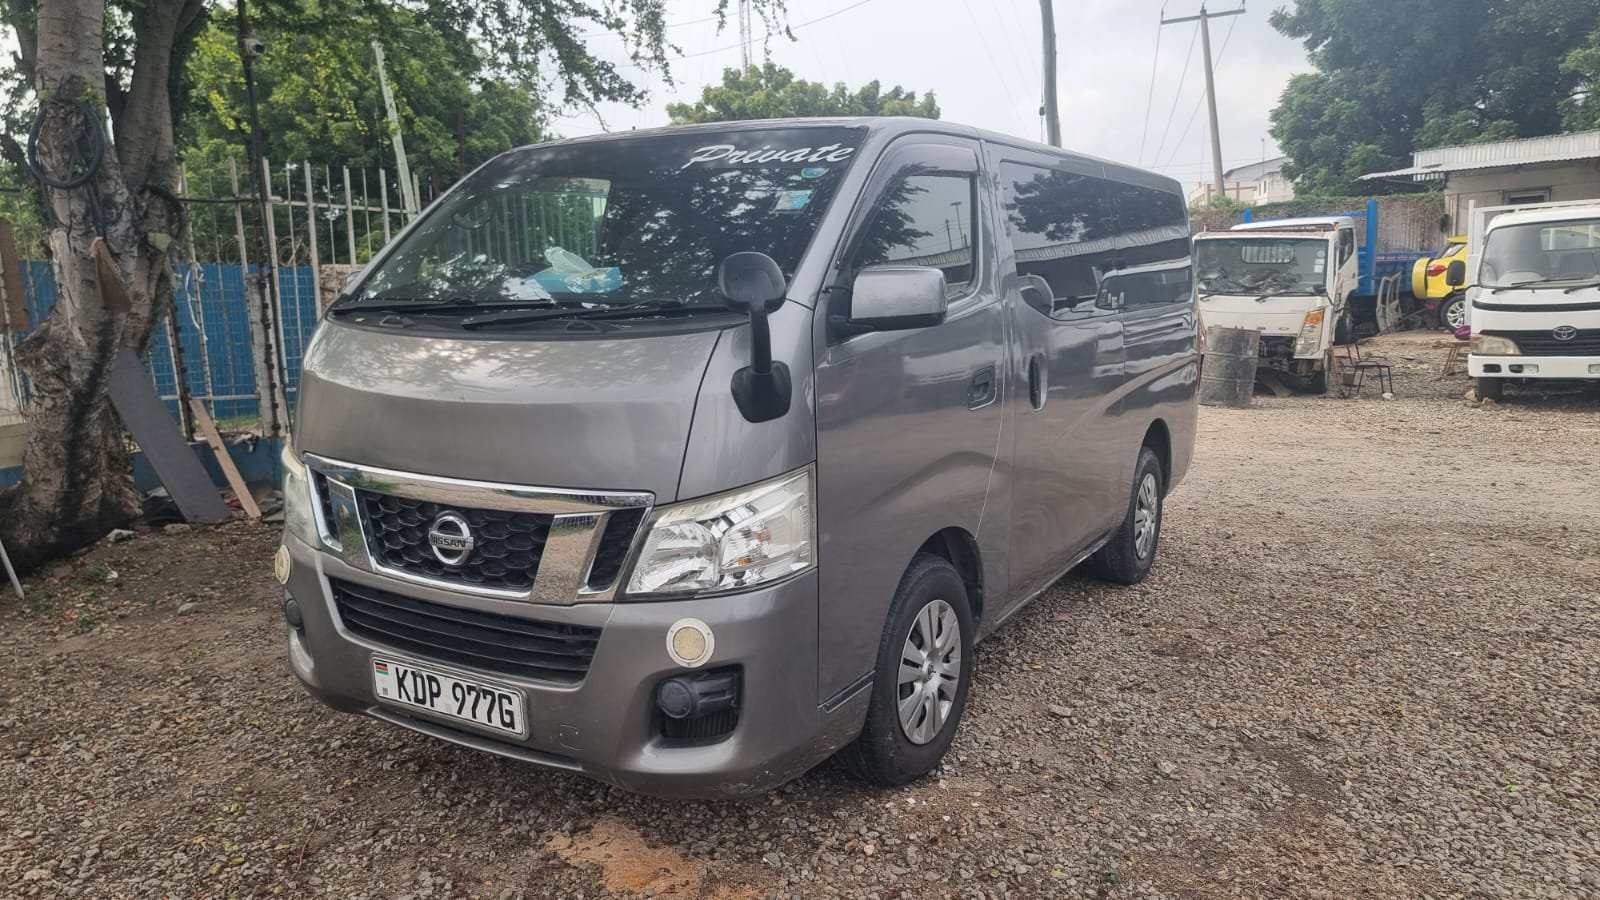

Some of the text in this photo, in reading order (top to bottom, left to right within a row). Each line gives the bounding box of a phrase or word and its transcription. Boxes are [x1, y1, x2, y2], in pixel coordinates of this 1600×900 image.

[681, 143, 854, 169] Private
[431, 534, 466, 548] NISSAN
[395, 667, 515, 730] KDP 977G
